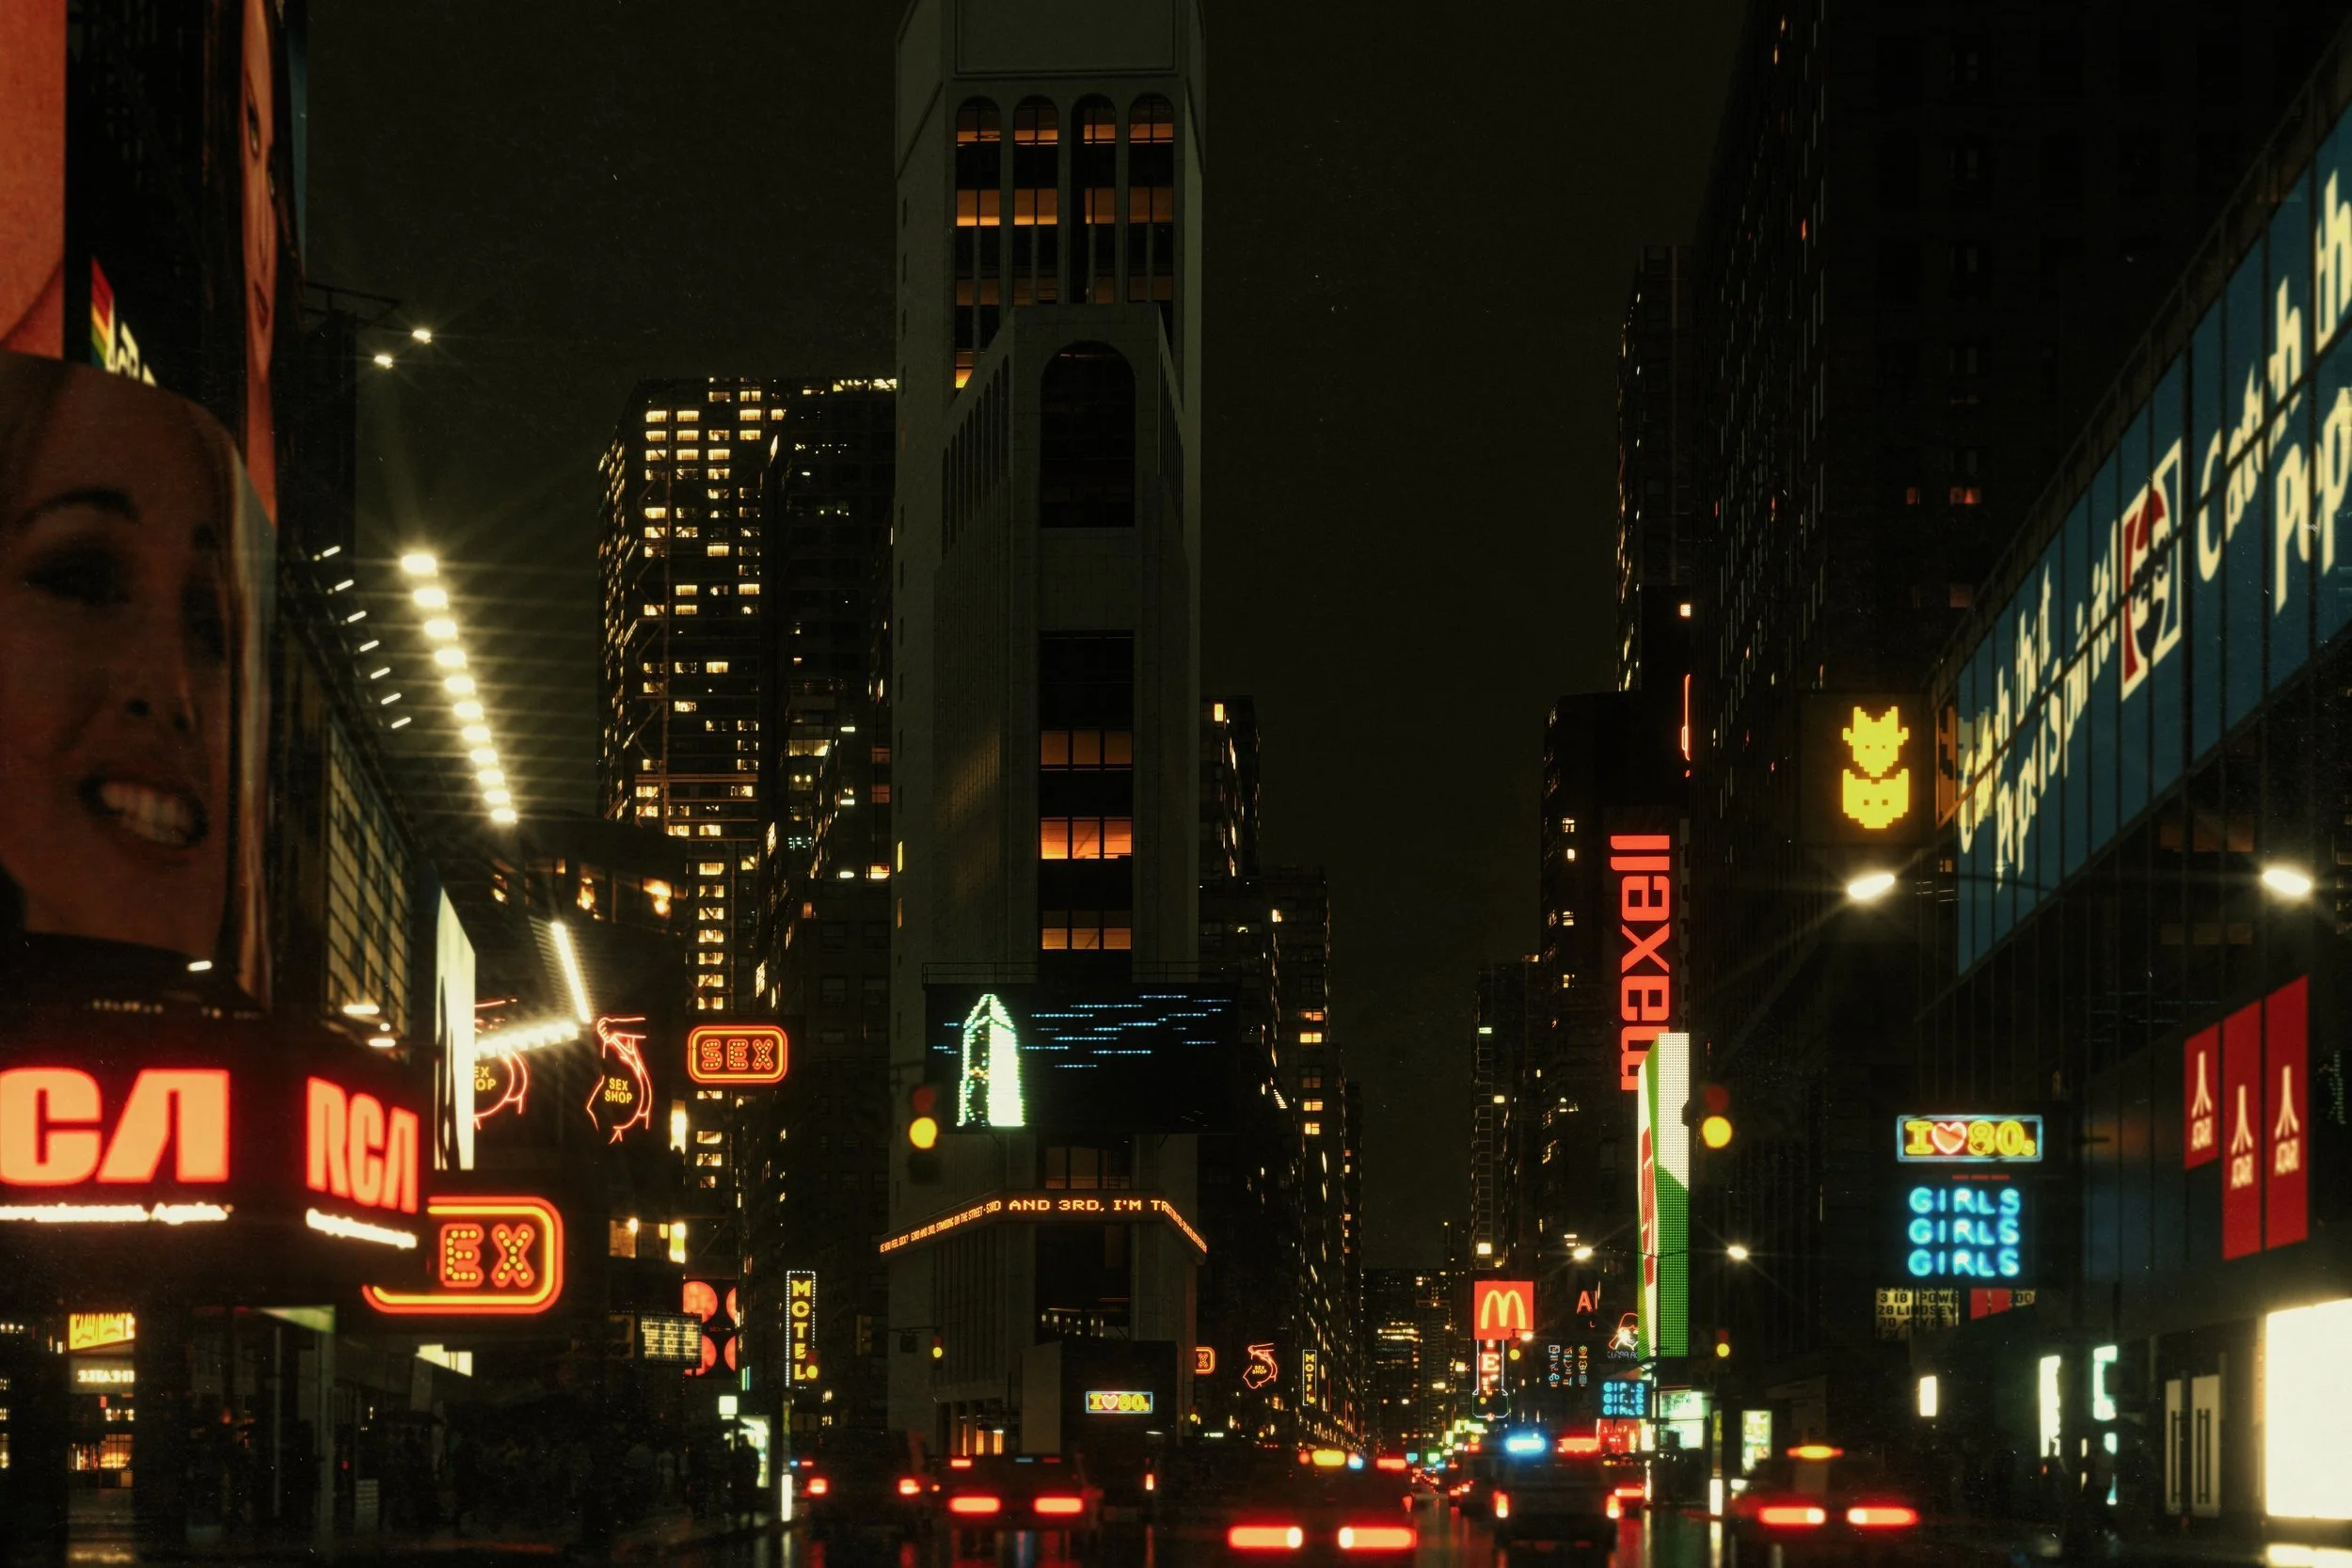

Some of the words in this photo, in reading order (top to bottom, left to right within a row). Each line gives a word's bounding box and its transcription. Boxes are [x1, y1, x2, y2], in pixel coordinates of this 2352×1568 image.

[2198, 277, 2301, 582] Catch
[1611, 835, 1669, 1090] maxell
[702, 1038, 773, 1070] SEX
[474, 1066, 489, 1078] EX
[474, 1078, 497, 1091] OP
[609, 1078, 628, 1092] SEX
[605, 1089, 633, 1104] SHOP
[307, 1076, 418, 1214] RCA
[1905, 1120, 1934, 1155] I
[1967, 1119, 2036, 1156] 80s
[1009, 1199, 1050, 1211] AND
[1058, 1199, 1105, 1212] 3RD,
[1113, 1199, 1141, 1211] I'M
[1909, 1186, 2020, 1215] GIRLS
[1909, 1217, 2020, 1245] GIRLS
[439, 1224, 535, 1288] EX
[1908, 1248, 2020, 1277] GIRLS
[791, 1280, 812, 1380] MOTEL
